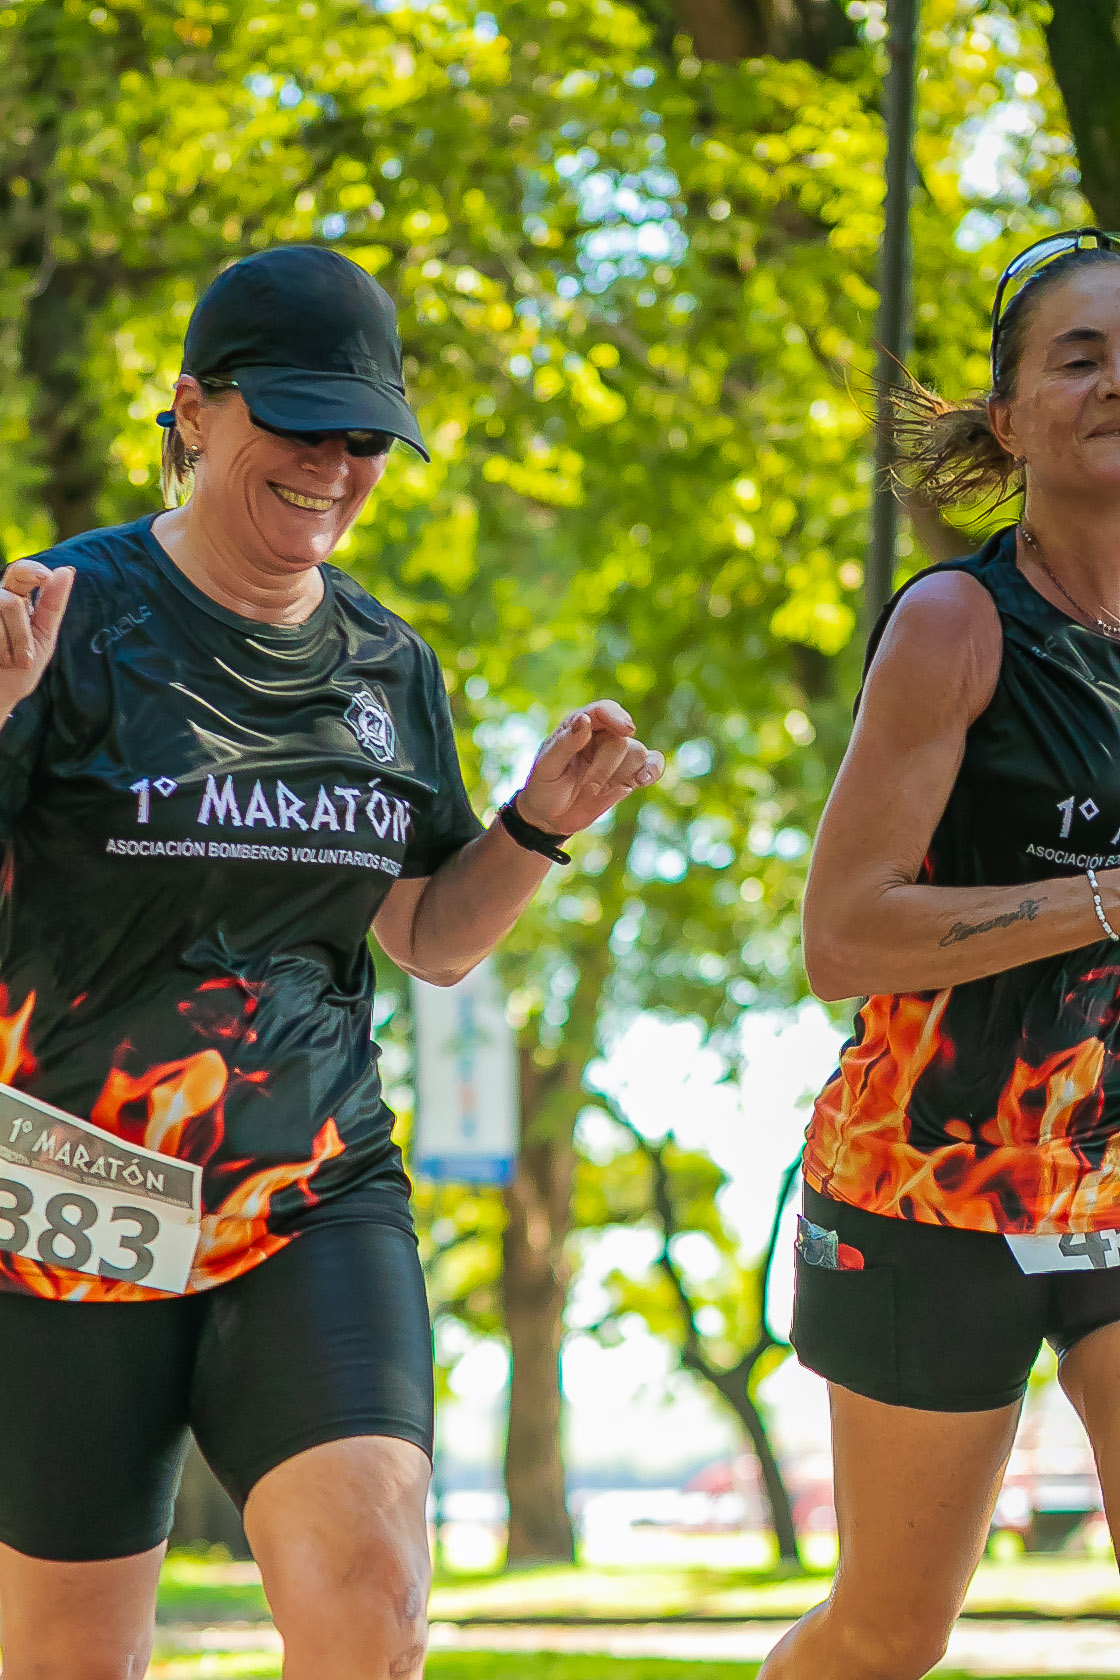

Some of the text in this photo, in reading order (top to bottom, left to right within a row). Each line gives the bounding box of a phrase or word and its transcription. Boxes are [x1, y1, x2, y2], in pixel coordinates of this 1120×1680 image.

[196, 773, 413, 844] MARATÓN
[106, 837, 206, 857] ASOCIACIÓN
[208, 841, 289, 862] BOMBEROS
[291, 846, 381, 869] VOLUNTARIOS
[32, 1130, 165, 1192] MARATÓN
[1058, 1226, 1120, 1270] 4
